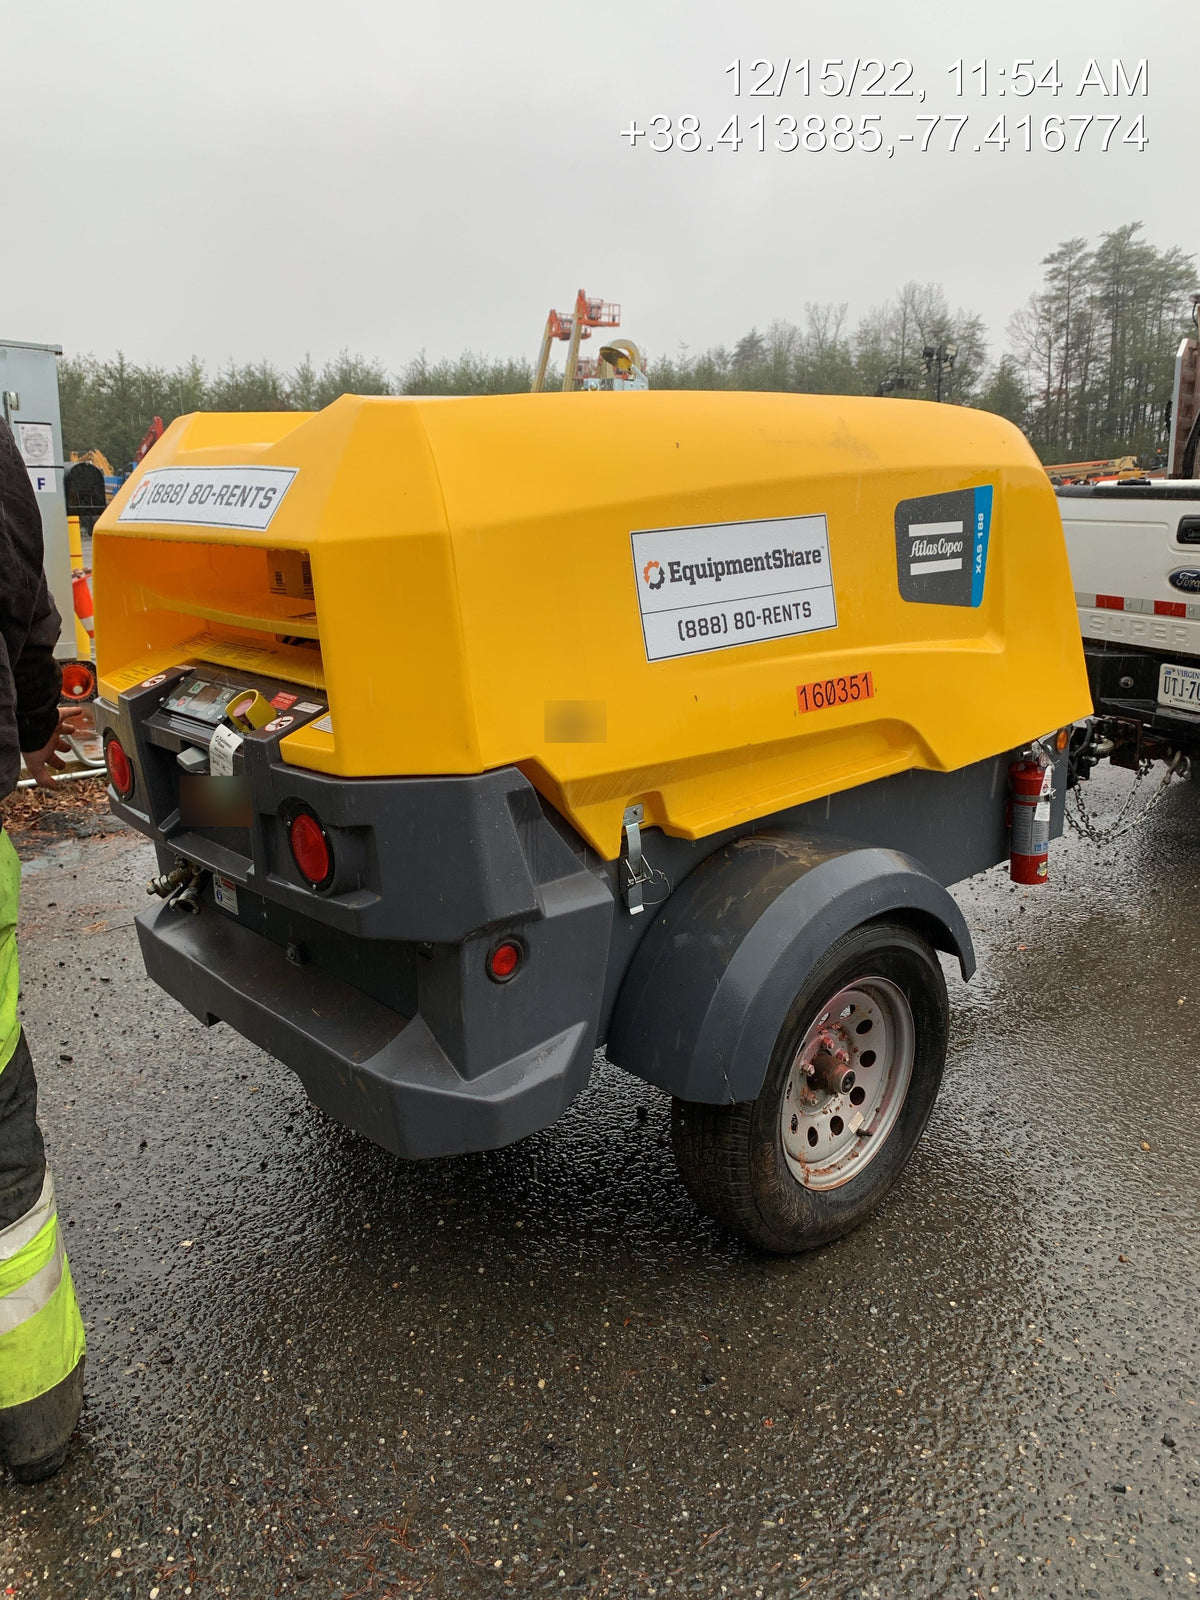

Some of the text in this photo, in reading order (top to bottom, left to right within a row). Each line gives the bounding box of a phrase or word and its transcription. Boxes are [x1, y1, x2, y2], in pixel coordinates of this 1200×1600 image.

[37, 477, 46, 491] F
[147, 482, 277, 509] (888) 80-RENTS
[668, 548, 822, 585] EquipmentShare
[975, 543, 983, 574] XAS
[677, 601, 812, 641] (888) 80-RENTS
[1089, 614, 1191, 646] SUPER
[800, 672, 870, 710] 160351
